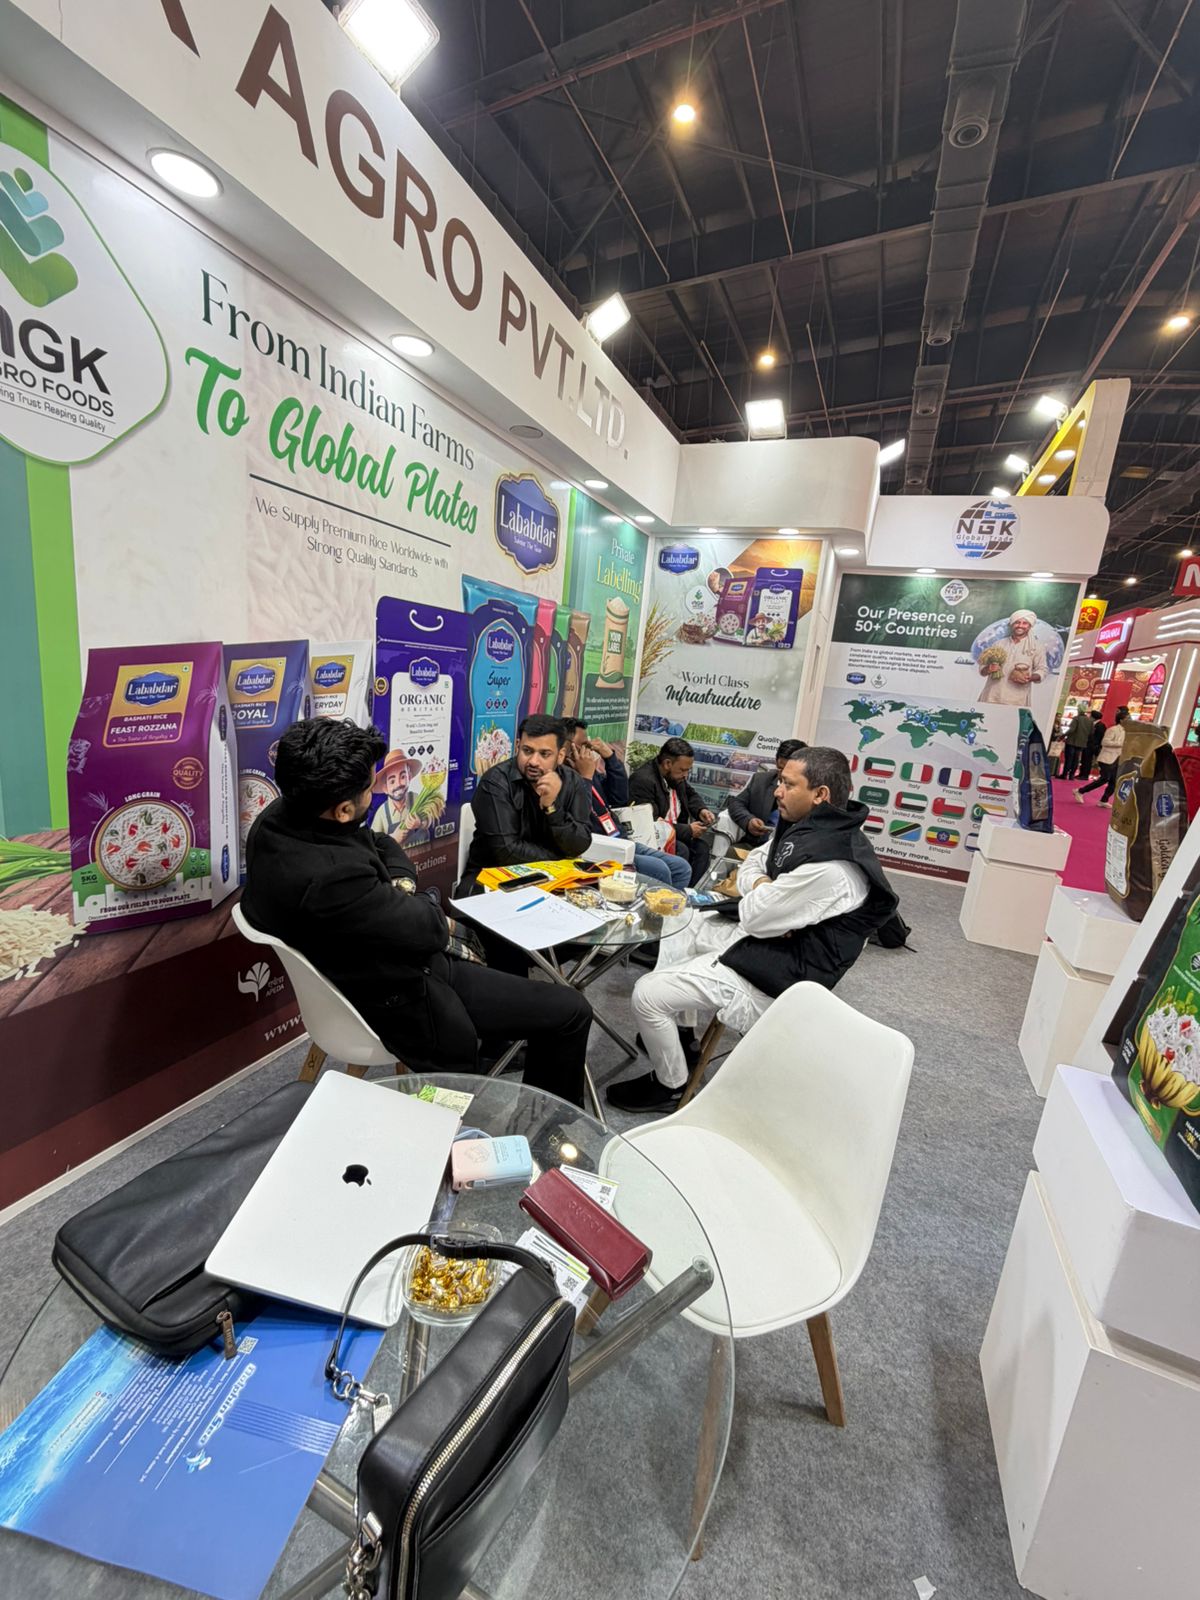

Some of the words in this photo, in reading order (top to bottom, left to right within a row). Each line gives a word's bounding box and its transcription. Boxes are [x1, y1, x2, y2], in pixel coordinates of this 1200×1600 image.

[235, 4, 483, 311] AGRO
[201, 269, 311, 381] From
[319, 344, 406, 433] Indian
[411, 403, 475, 471] Farms
[0, 361, 37, 388] RO
[42, 377, 114, 417] FOODS
[17, 391, 41, 409] Trust
[44, 401, 77, 423] Reaping
[79, 414, 106, 433] Quality
[185, 347, 249, 436] To
[269, 397, 397, 499] Global
[405, 461, 478, 534] Plates
[500, 494, 557, 548] Lababdar
[956, 519, 1016, 536] NGK
[256, 497, 278, 518] We
[282, 506, 320, 534] Supply
[323, 518, 367, 546] Premium
[369, 533, 388, 551] Rice
[391, 540, 432, 565] Worldwide
[434, 557, 449, 569] with
[307, 536, 343, 564] Strong
[346, 547, 377, 571] Quality
[379, 556, 418, 578] Standards
[611, 538, 635, 565] Private
[661, 552, 698, 565] Lababdar
[597, 555, 642, 604] Labelling
[857, 605, 885, 619] Our
[887, 607, 956, 624] Presence
[959, 612, 974, 625] in
[609, 631, 622, 641] YOUR
[854, 620, 881, 632] 50+
[885, 621, 958, 639] Countries
[487, 636, 514, 653] Lababdar
[608, 641, 622, 653] LABEL
[316, 669, 345, 679] Lababdar
[411, 665, 438, 678] Lababdar
[487, 670, 511, 688] Super
[237, 674, 274, 686] Lababdar
[681, 671, 716, 686] World
[718, 674, 750, 689] Class
[128, 681, 178, 696] Lababdar
[399, 693, 447, 705] ORGANIC
[665, 684, 761, 711] Infrastructure
[315, 701, 344, 710] ERYDAY
[124, 714, 152, 722] BASMATI
[111, 726, 137, 735] FEAST
[138, 722, 177, 732] ROZZANA
[173, 769, 203, 777] QUALITY
[124, 792, 142, 802] LONG
[979, 794, 1006, 802] Lebanon
[892, 810, 911, 818] United
[911, 812, 925, 820] Arab
[937, 817, 956, 825] Oman
[891, 838, 916, 848] Tanzania
[928, 846, 951, 854] Ethiopia
[886, 847, 908, 858] Many
[81, 874, 98, 882] 5KG
[100, 905, 117, 914] FROM
[118, 903, 130, 911] OUR
[130, 900, 150, 909] FIELDS
[159, 897, 174, 905] YOUR
[174, 893, 191, 902] PLATE
[265, 983, 284, 998] APEDA
[218, 1364, 256, 1416] Dolphin
[199, 1414, 223, 1447] Sea
